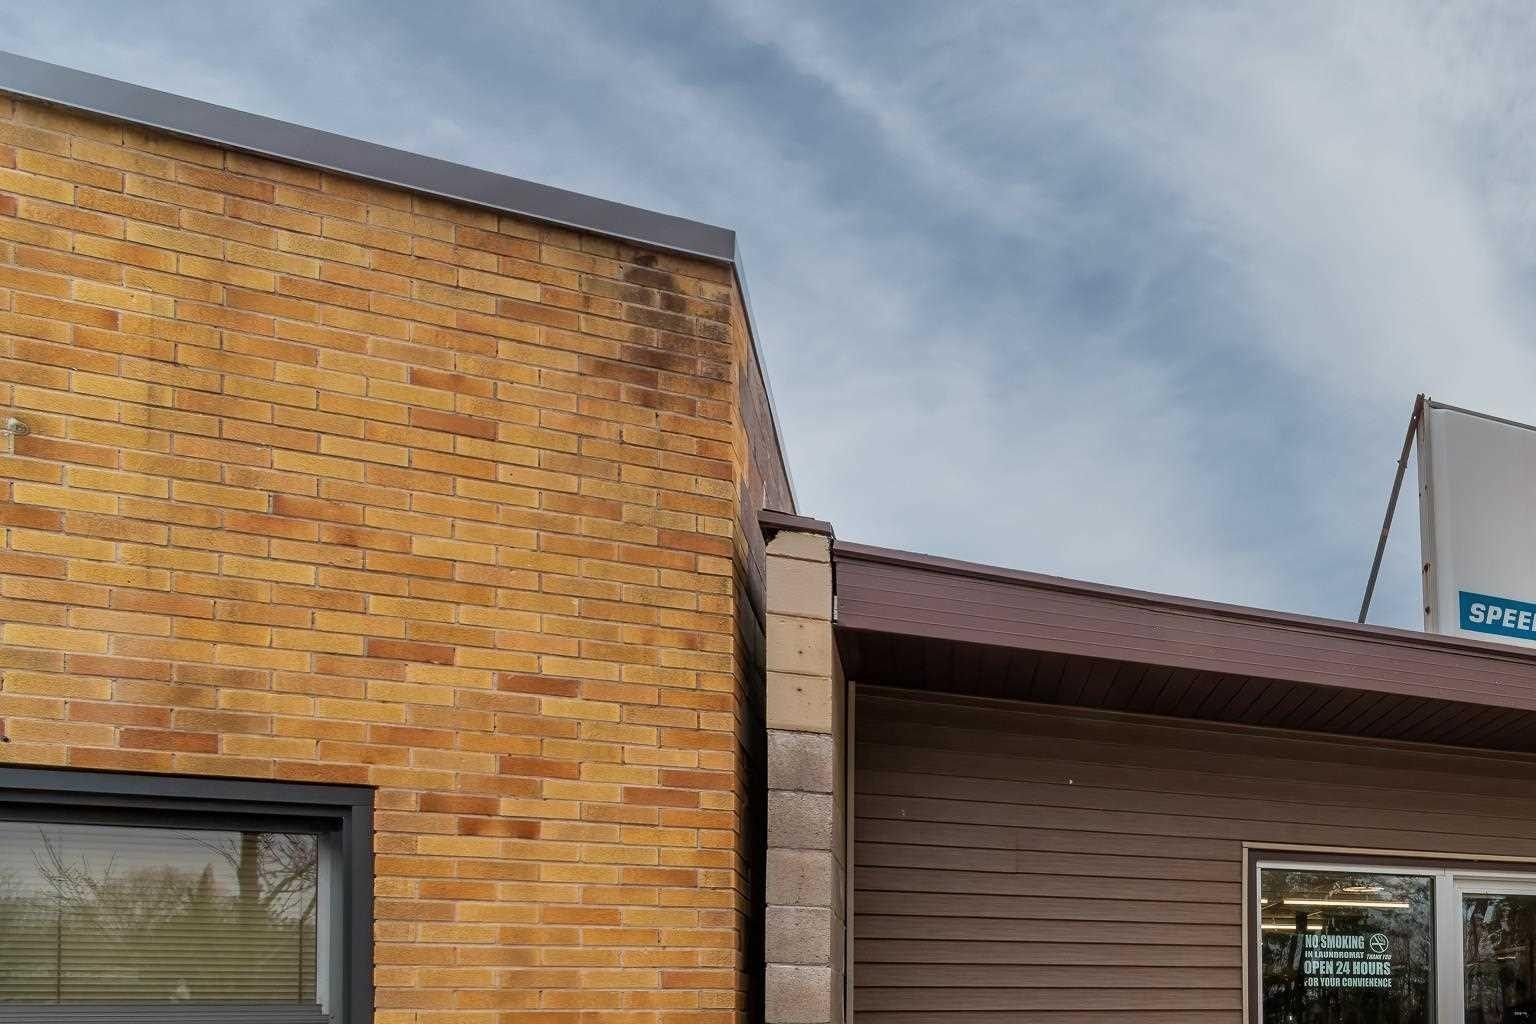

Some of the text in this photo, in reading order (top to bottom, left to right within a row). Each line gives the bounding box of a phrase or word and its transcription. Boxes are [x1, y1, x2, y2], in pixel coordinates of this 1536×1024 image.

[1304, 934, 1365, 949] NO SMOKING
[1304, 950, 1365, 959] IN LAUNDROMAT
[1303, 960, 1391, 976] OPEN 24 HOURS
[1303, 977, 1319, 987] FOR
[1320, 977, 1341, 987] YOUR
